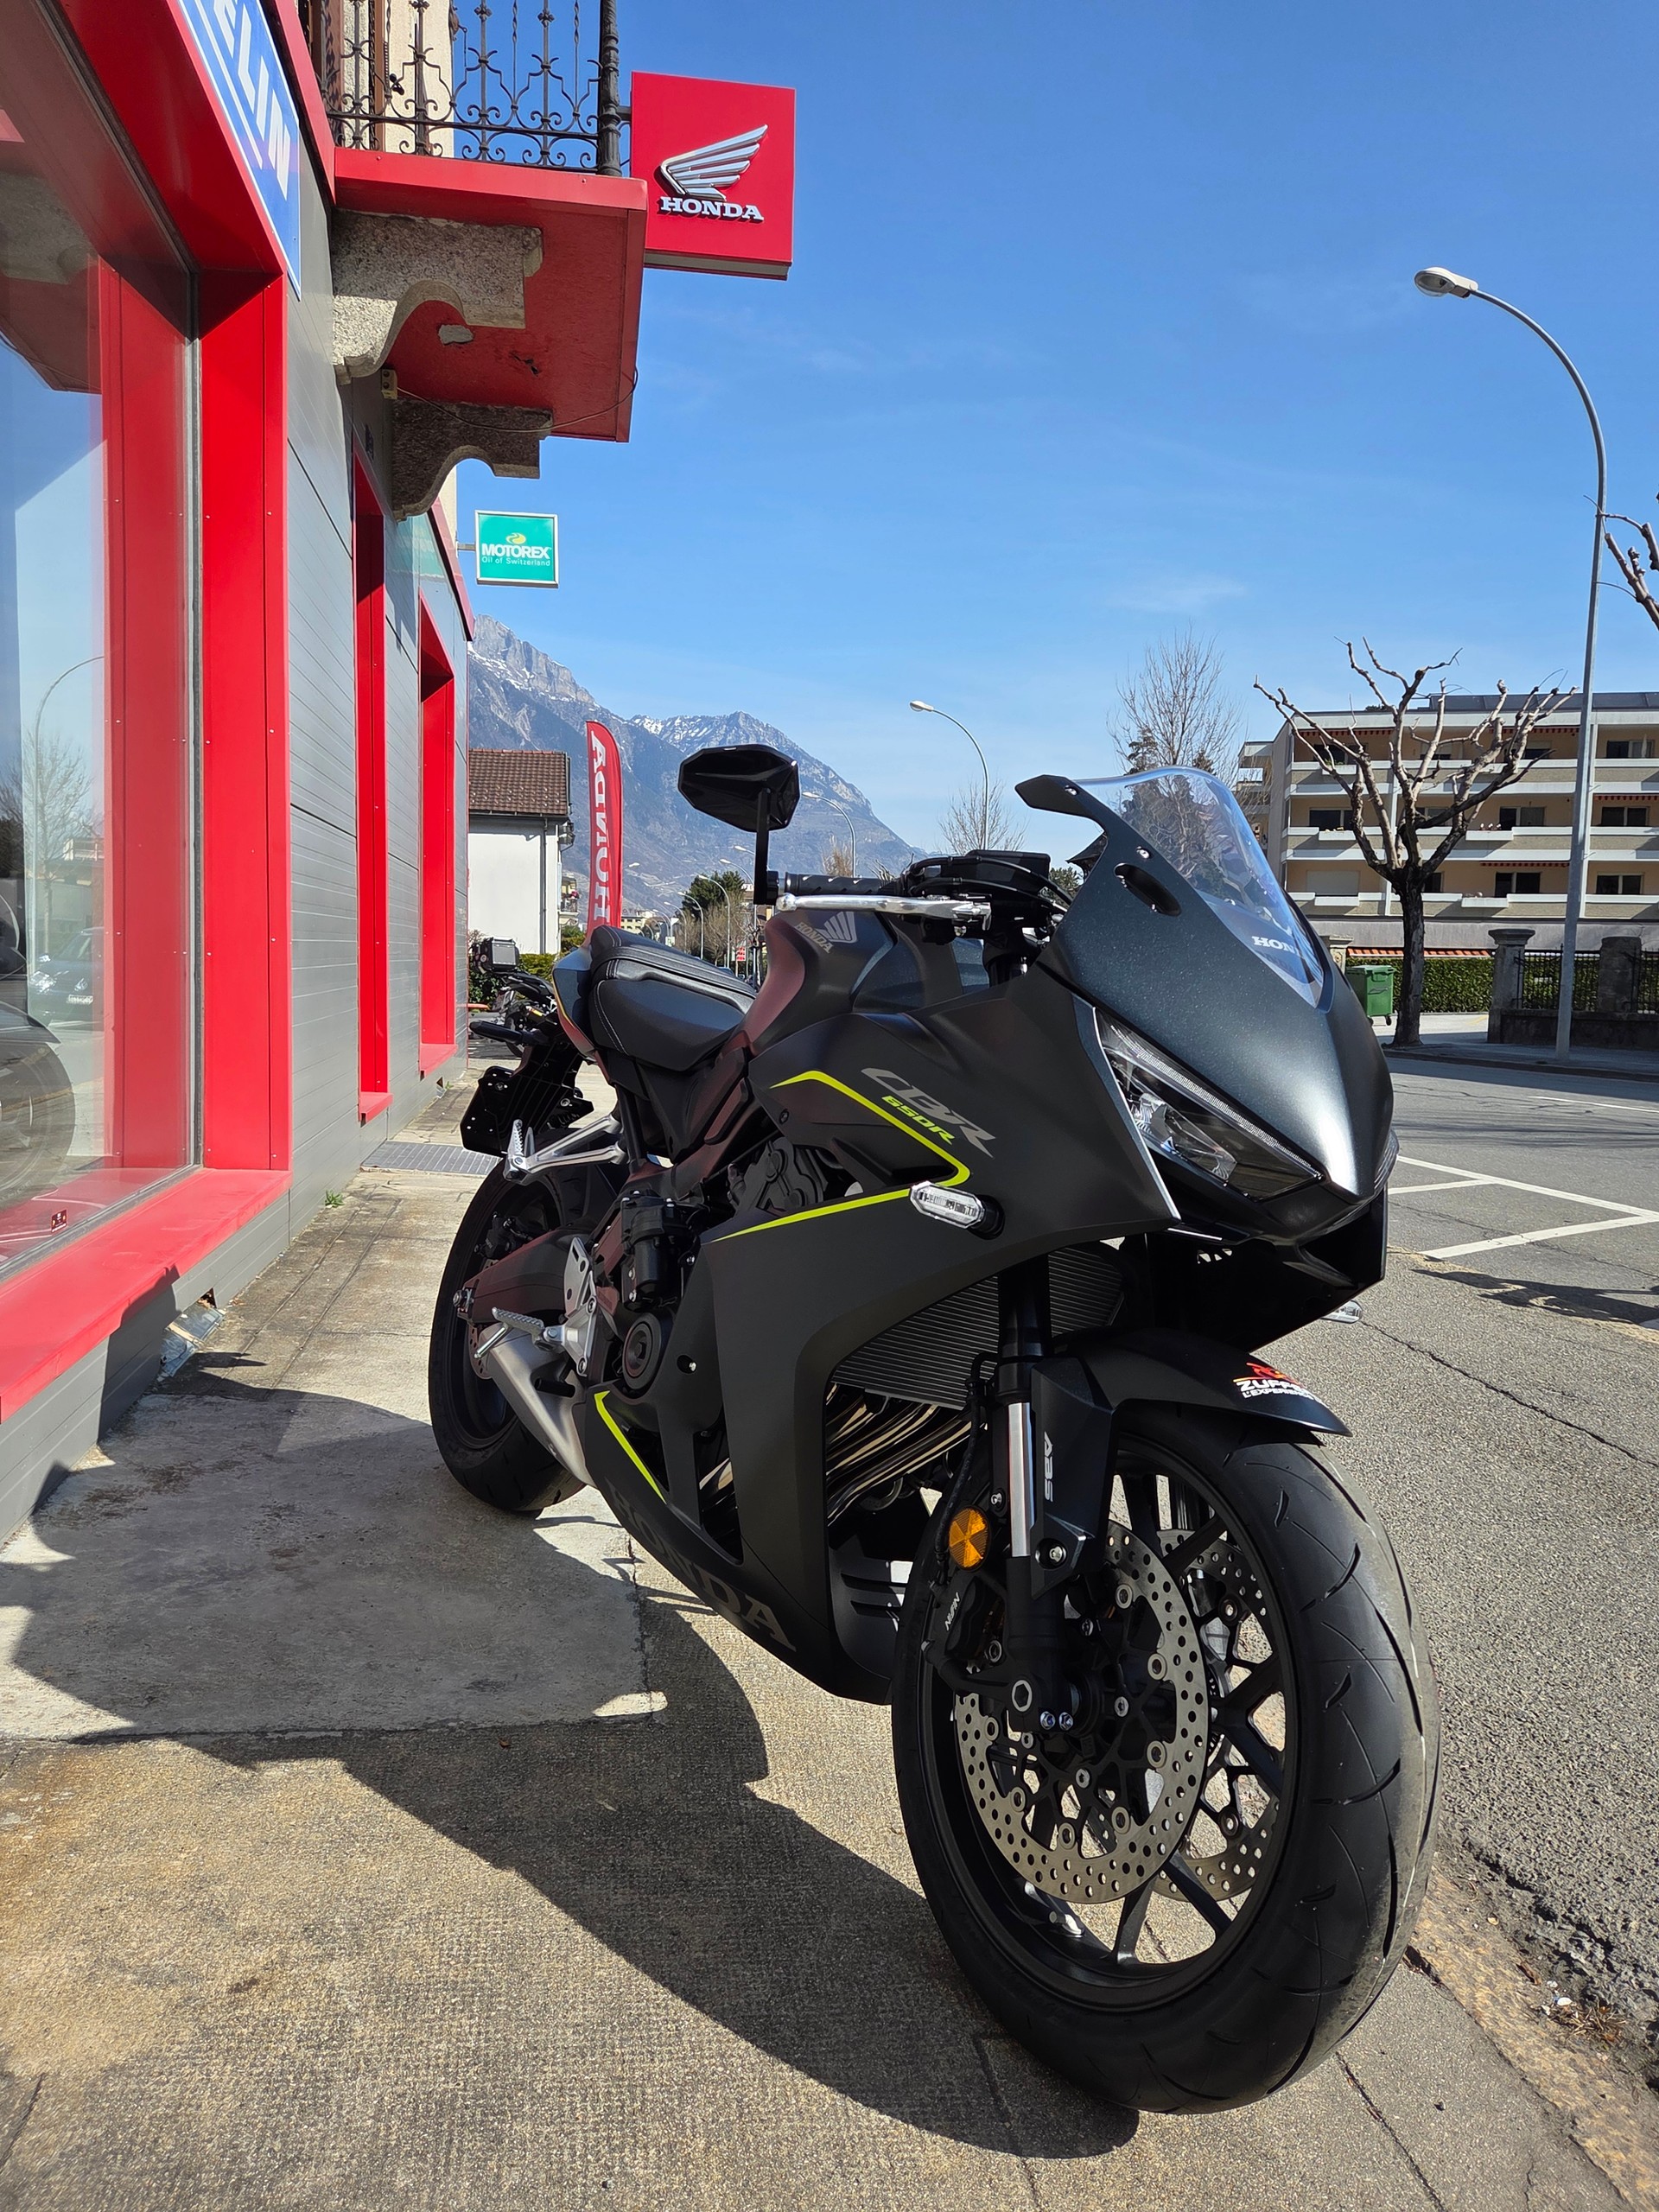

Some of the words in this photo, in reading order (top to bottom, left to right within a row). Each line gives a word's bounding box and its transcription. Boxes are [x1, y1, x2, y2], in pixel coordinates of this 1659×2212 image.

[660, 196, 765, 221] HONDA
[481, 543, 550, 559] MOTOREX
[505, 557, 550, 567] Switzerland
[795, 922, 834, 954] HONDA
[861, 1068, 995, 1158] CBR
[881, 1096, 955, 1145] 650R
[1044, 1431, 1053, 1503] ABS
[604, 1476, 797, 1653] HONDA
